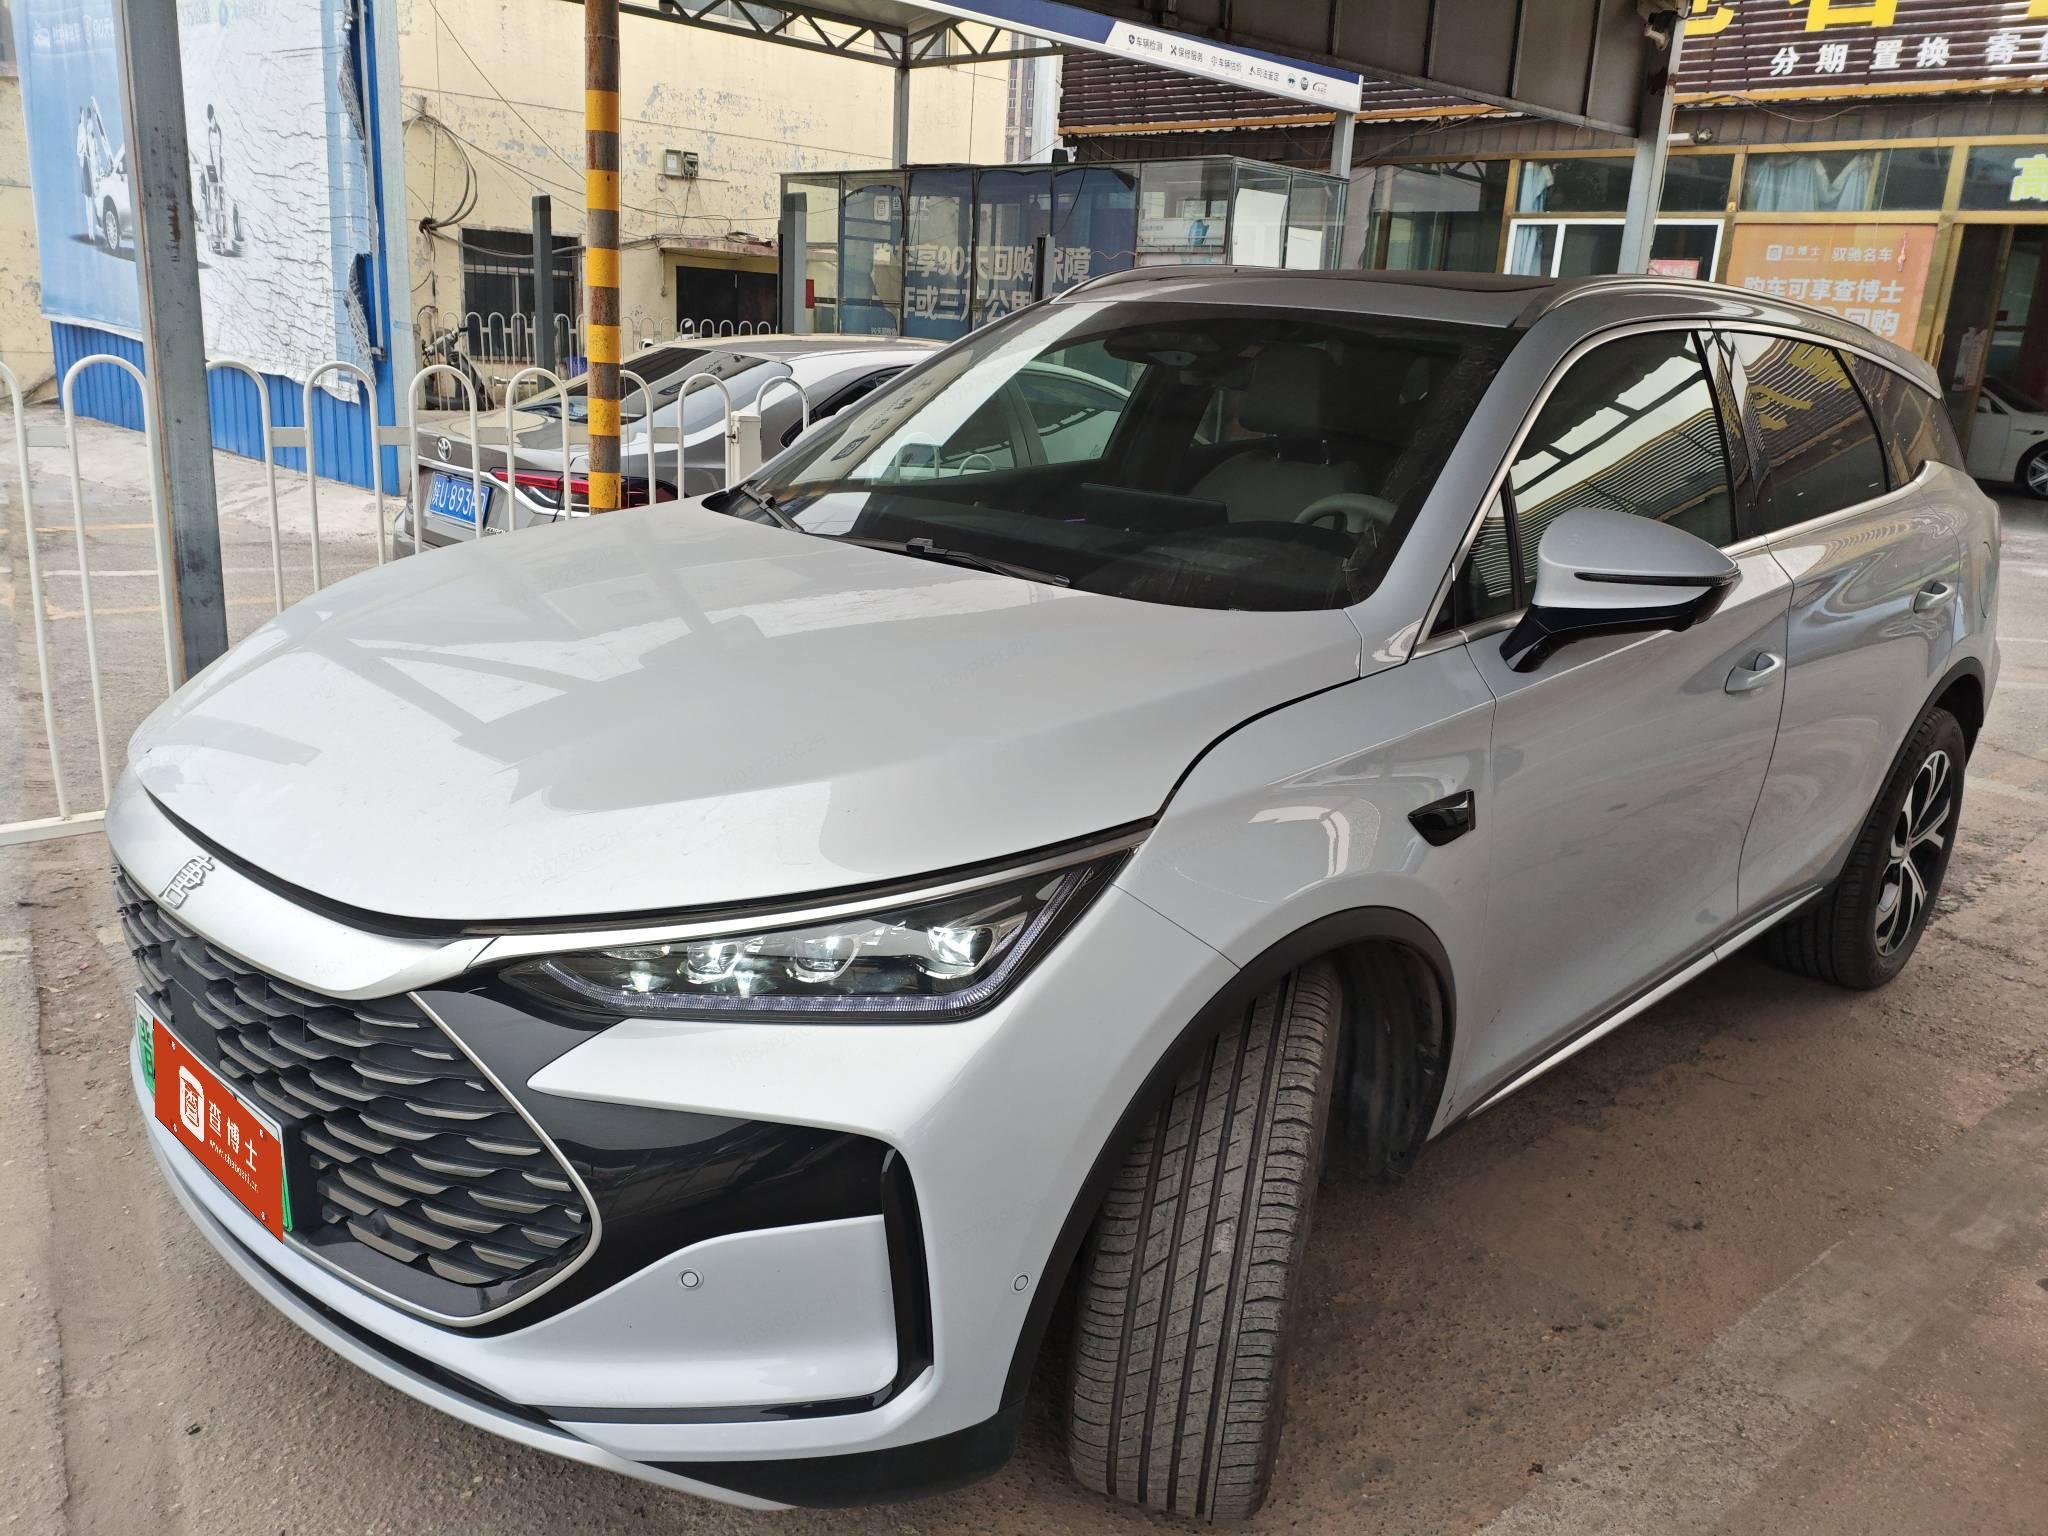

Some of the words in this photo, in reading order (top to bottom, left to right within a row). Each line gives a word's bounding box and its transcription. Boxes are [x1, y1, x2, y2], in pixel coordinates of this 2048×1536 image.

[1769, 36, 1951, 77] 分期置换
[1744, 276, 1905, 304] 购车可享查博士
[208, 1100, 258, 1172] 查博士
